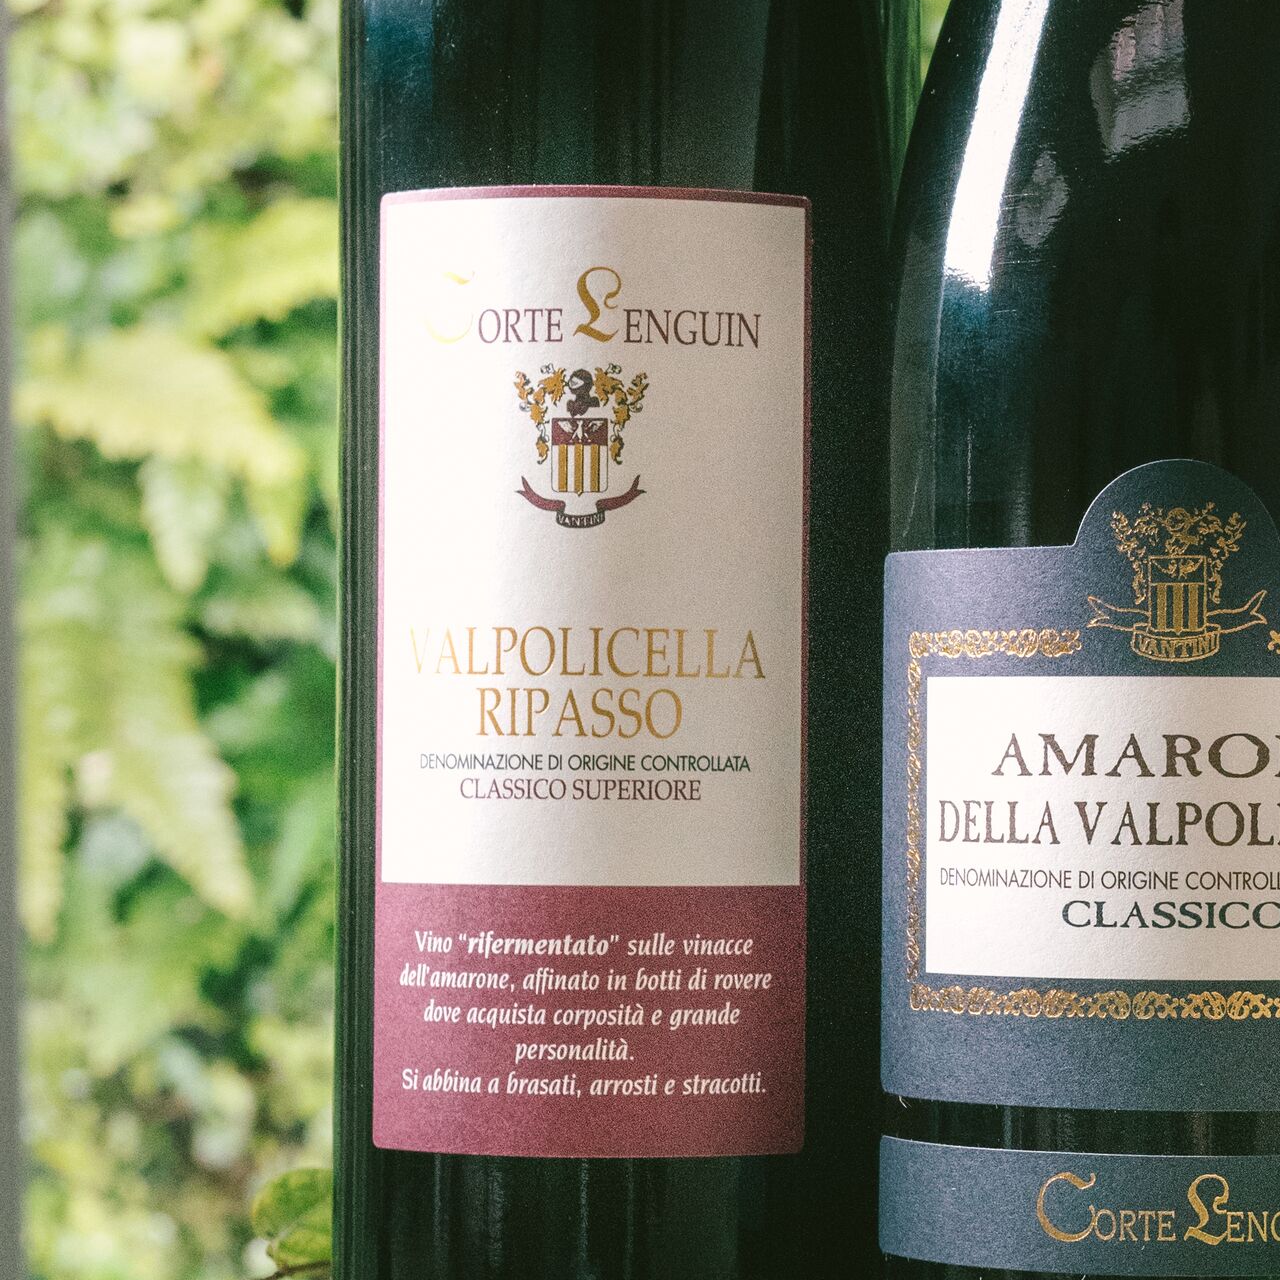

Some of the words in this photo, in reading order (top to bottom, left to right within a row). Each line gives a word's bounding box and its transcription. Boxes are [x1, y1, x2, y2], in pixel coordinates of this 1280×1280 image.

[409, 624, 766, 679] VALPOLICELLA
[476, 687, 683, 739] RIPASSO
[420, 753, 543, 771] DENOMINAZIONE
[548, 754, 563, 771] DI
[568, 754, 636, 772] ORIGINE
[640, 754, 751, 773] CONTROLLATA
[460, 778, 566, 801] CLASSICO
[573, 779, 702, 801] SUPERIORE
[938, 799, 1059, 846] DELLA
[940, 867, 1072, 889] DENOMINAZIONE
[1077, 869, 1095, 889] DI
[1101, 869, 1179, 890] ORIGINE
[414, 930, 452, 954] Vino
[627, 933, 675, 956] sulle
[683, 934, 754, 956] vinacce
[399, 963, 515, 992] dell'amarone,
[522, 967, 600, 995] affinato
[607, 969, 626, 991] in
[635, 967, 682, 991] botti
[687, 967, 708, 991] di
[713, 971, 772, 990] rovere
[423, 999, 461, 1023] dove
[466, 1003, 546, 1030] acquista
[553, 1004, 644, 1030] corposità
[651, 1010, 662, 1026] e
[669, 1002, 740, 1030] grande
[515, 1038, 635, 1064] personalità.
[401, 1068, 417, 1091] Si
[422, 1068, 482, 1094] abbina
[487, 1077, 499, 1094] a
[506, 1073, 582, 1099] brasati,
[590, 1073, 658, 1097] arrosti
[664, 1079, 675, 1095] e
[682, 1073, 767, 1096] stracotti.
